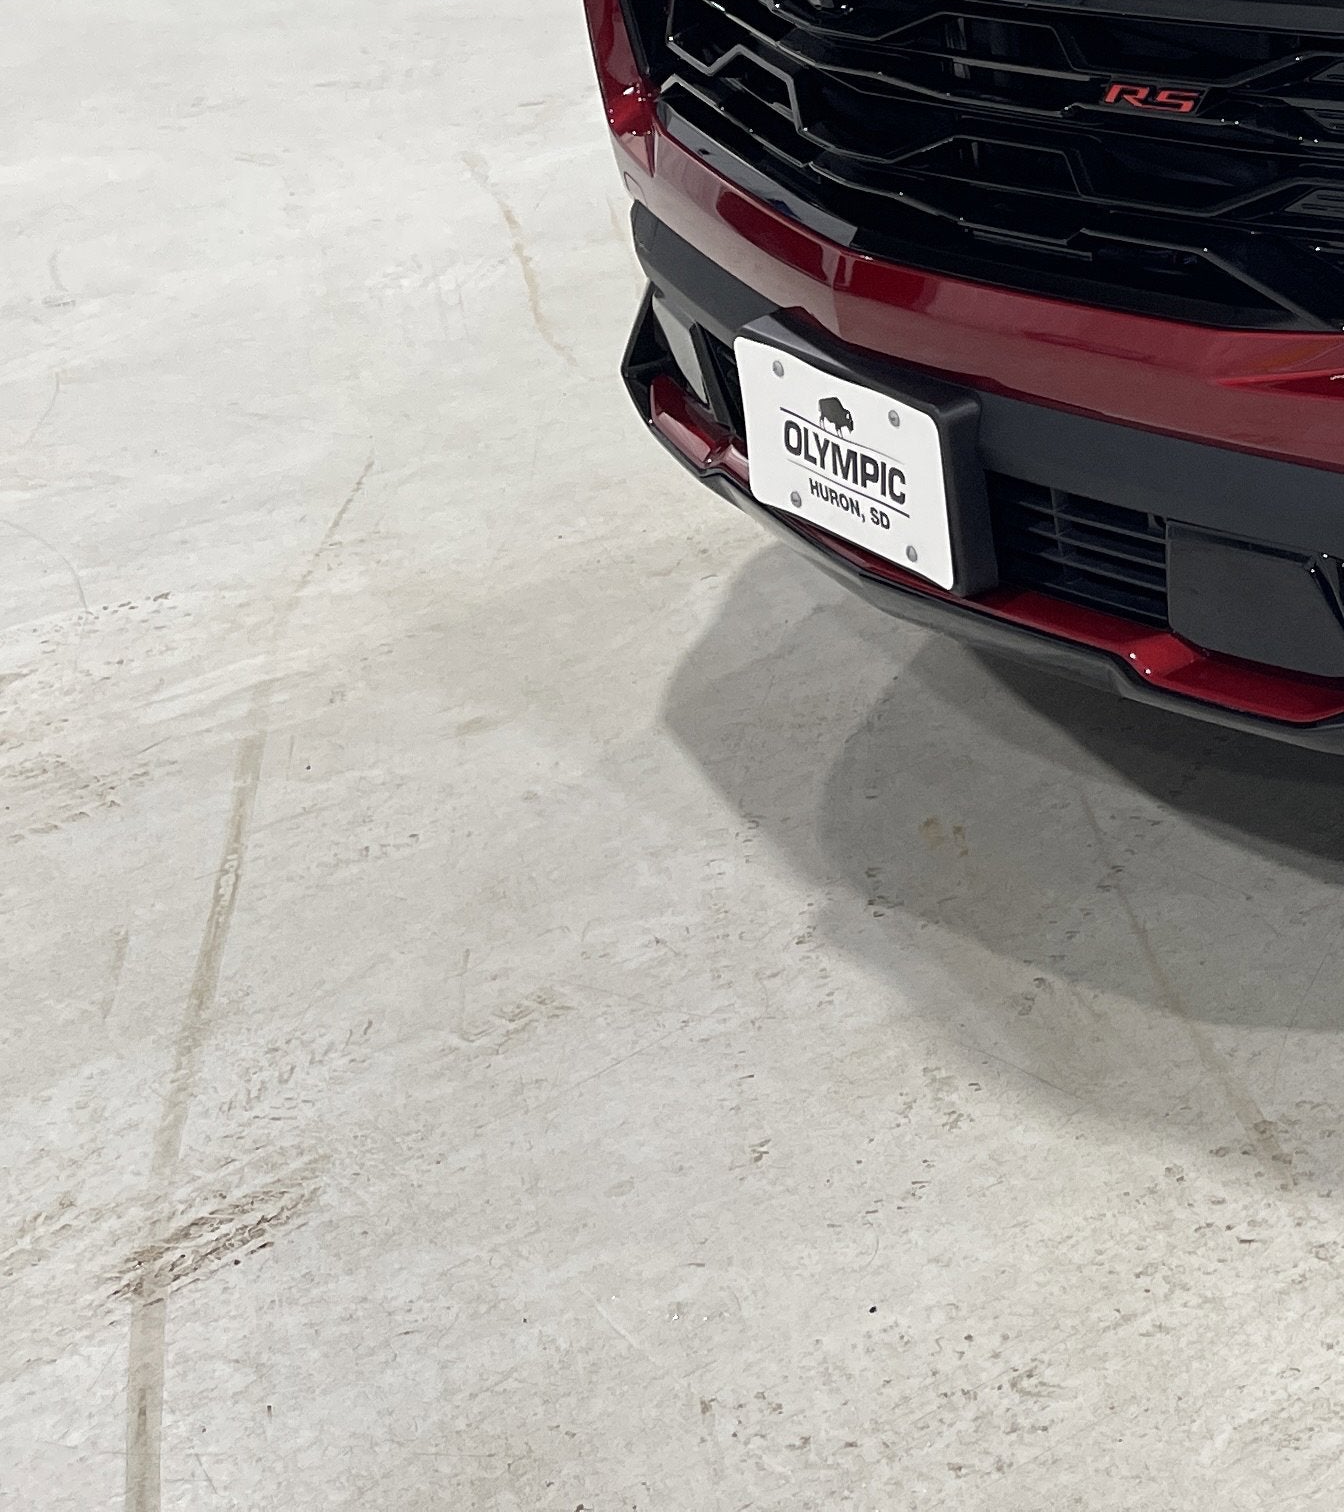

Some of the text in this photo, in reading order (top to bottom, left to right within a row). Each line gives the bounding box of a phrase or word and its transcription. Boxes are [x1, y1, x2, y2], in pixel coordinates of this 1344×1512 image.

[1104, 84, 1200, 113] RS
[784, 419, 907, 505] OLYMPIC
[808, 477, 891, 530] HURON, SD
